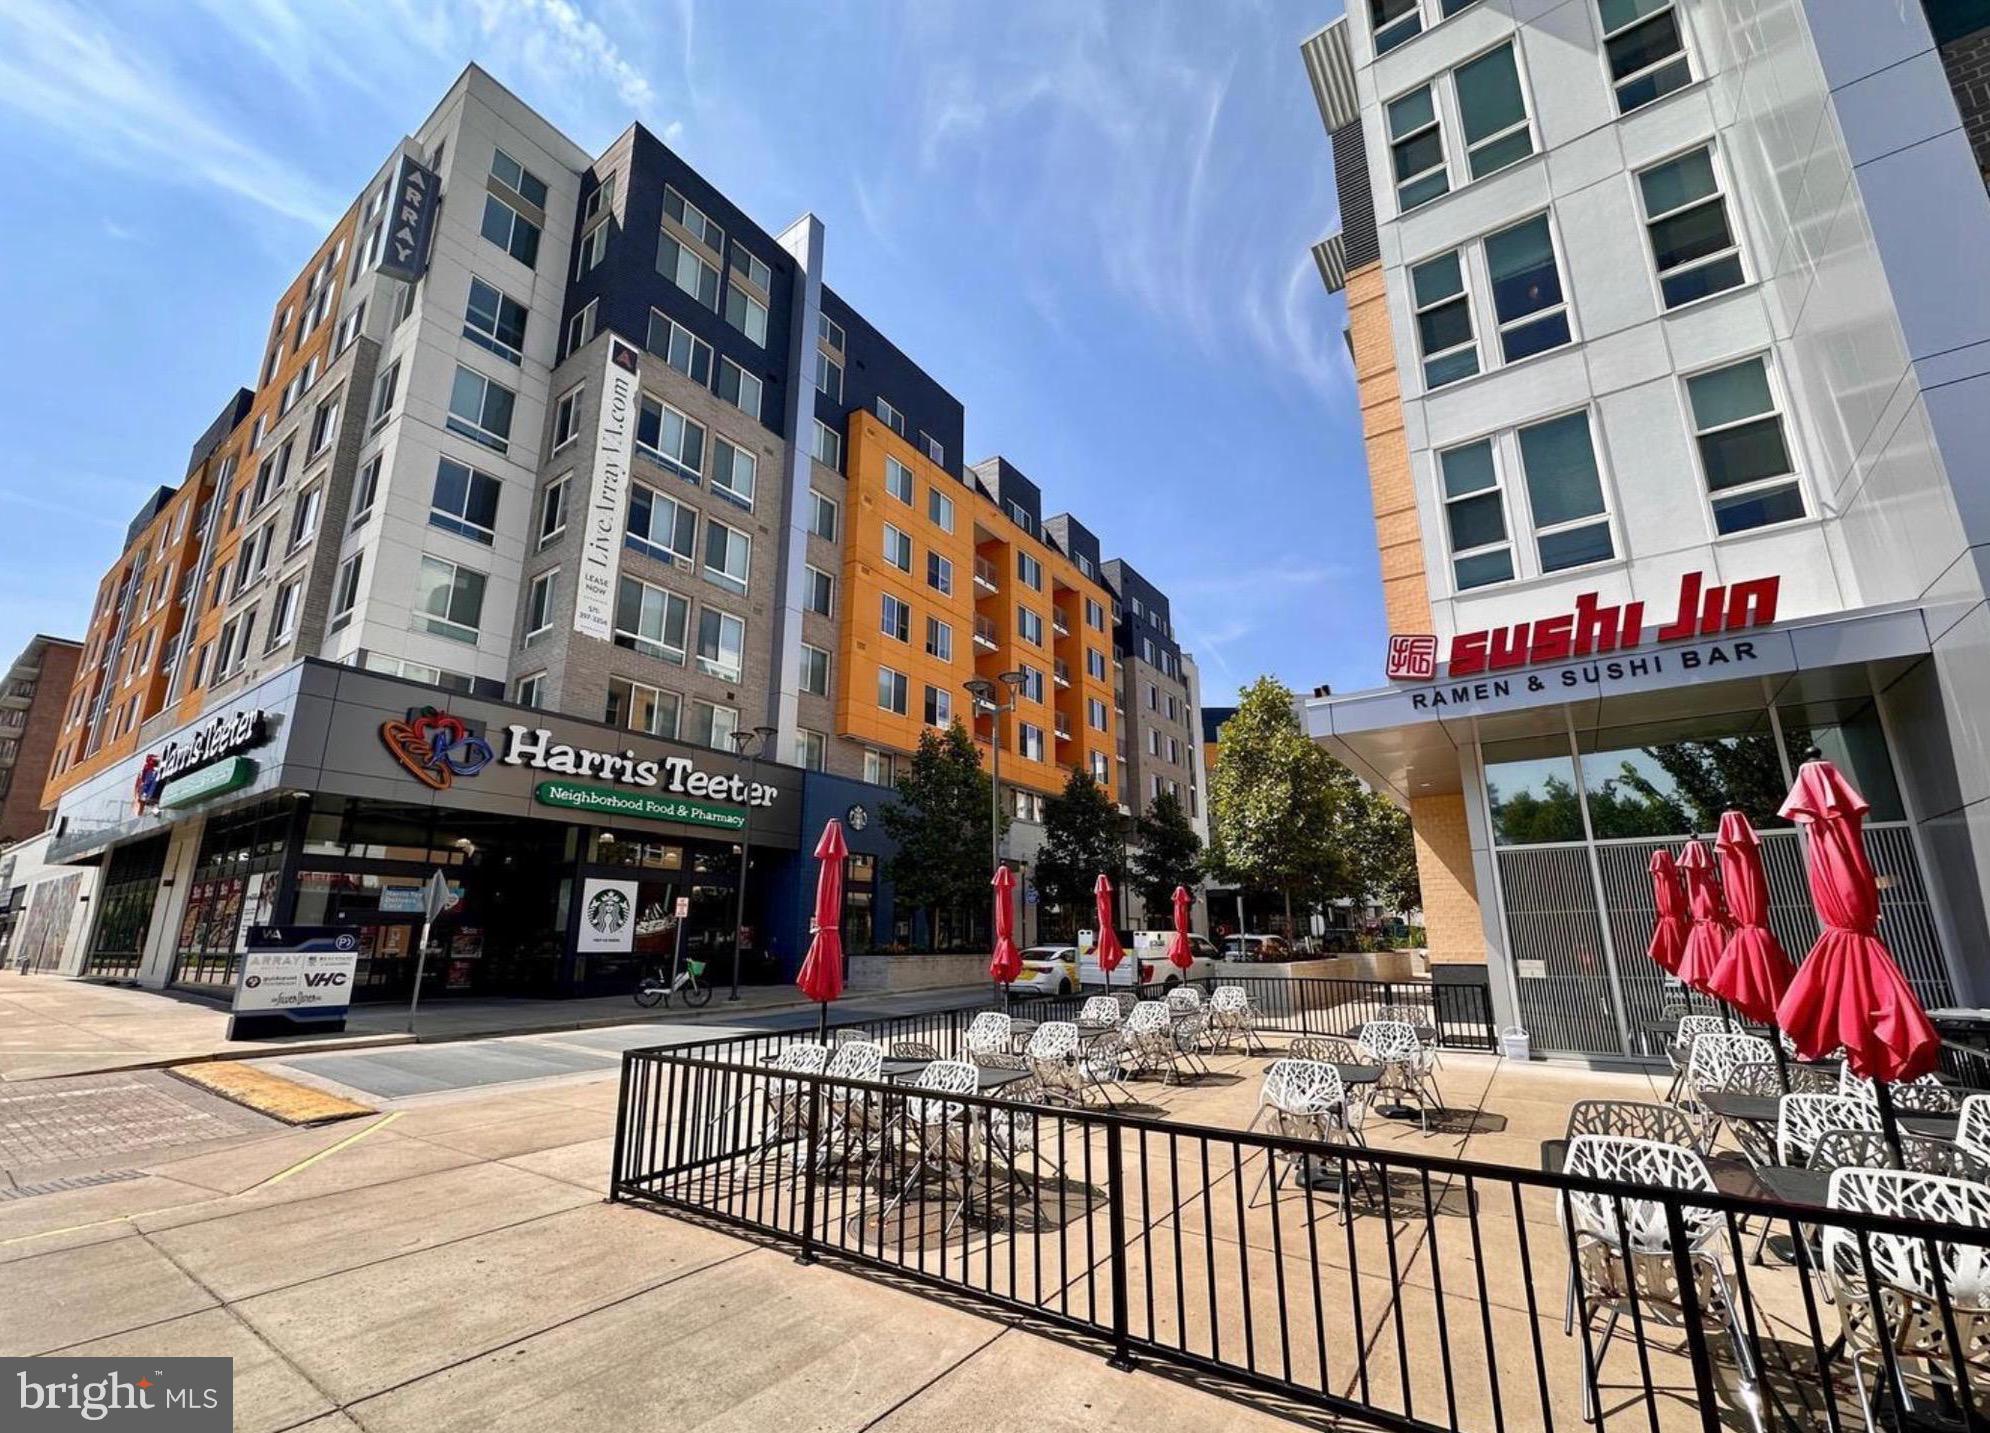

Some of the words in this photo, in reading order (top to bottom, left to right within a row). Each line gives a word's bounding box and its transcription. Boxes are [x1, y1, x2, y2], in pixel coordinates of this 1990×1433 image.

[395, 170, 425, 262] ARRAY
[584, 574, 609, 588] LEASE
[585, 584, 606, 596] NOW
[1413, 681, 1509, 710] RAMEN
[1528, 676, 1545, 692] &
[1562, 655, 1662, 687] SUSHI
[1682, 642, 1757, 669] BAR
[156, 736, 202, 781] Harris
[203, 709, 258, 762] Teeter
[504, 725, 659, 786] Harris
[665, 756, 778, 806] Teeter
[549, 786, 643, 811] Neighborhood
[646, 801, 675, 816] Food
[676, 804, 689, 817] &
[691, 807, 745, 827] Pharmacy
[250, 956, 301, 966] ARRAY
[304, 972, 347, 988] VHC
